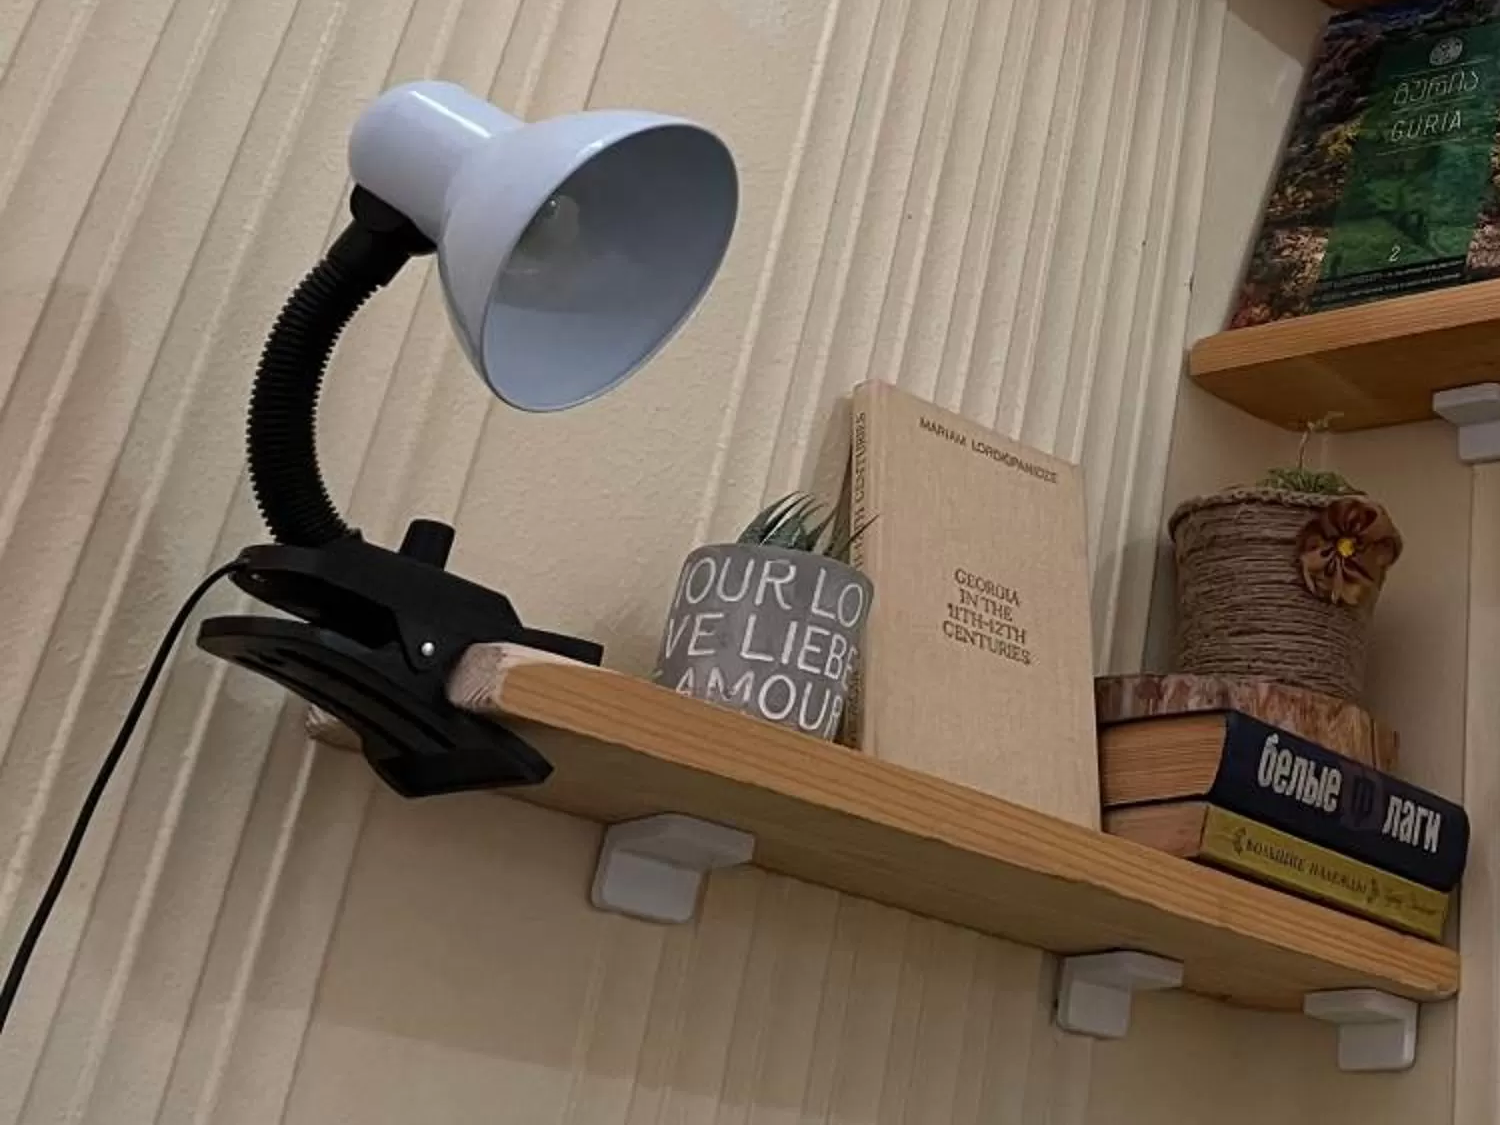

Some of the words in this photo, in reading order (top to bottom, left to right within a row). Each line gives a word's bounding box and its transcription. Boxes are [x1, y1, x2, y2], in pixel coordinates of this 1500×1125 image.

[1391, 109, 1461, 142] GURIA
[919, 416, 967, 447] MARIAM
[811, 567, 863, 628] LO
[954, 567, 1020, 608] GEORGIA
[959, 588, 980, 608] IN
[980, 596, 1013, 623] THE
[664, 613, 725, 659] VE
[740, 614, 860, 691] LIEBE
[943, 620, 1032, 666] CENTURIES
[675, 667, 844, 739] AMOUR
[1257, 733, 1343, 813] белые
